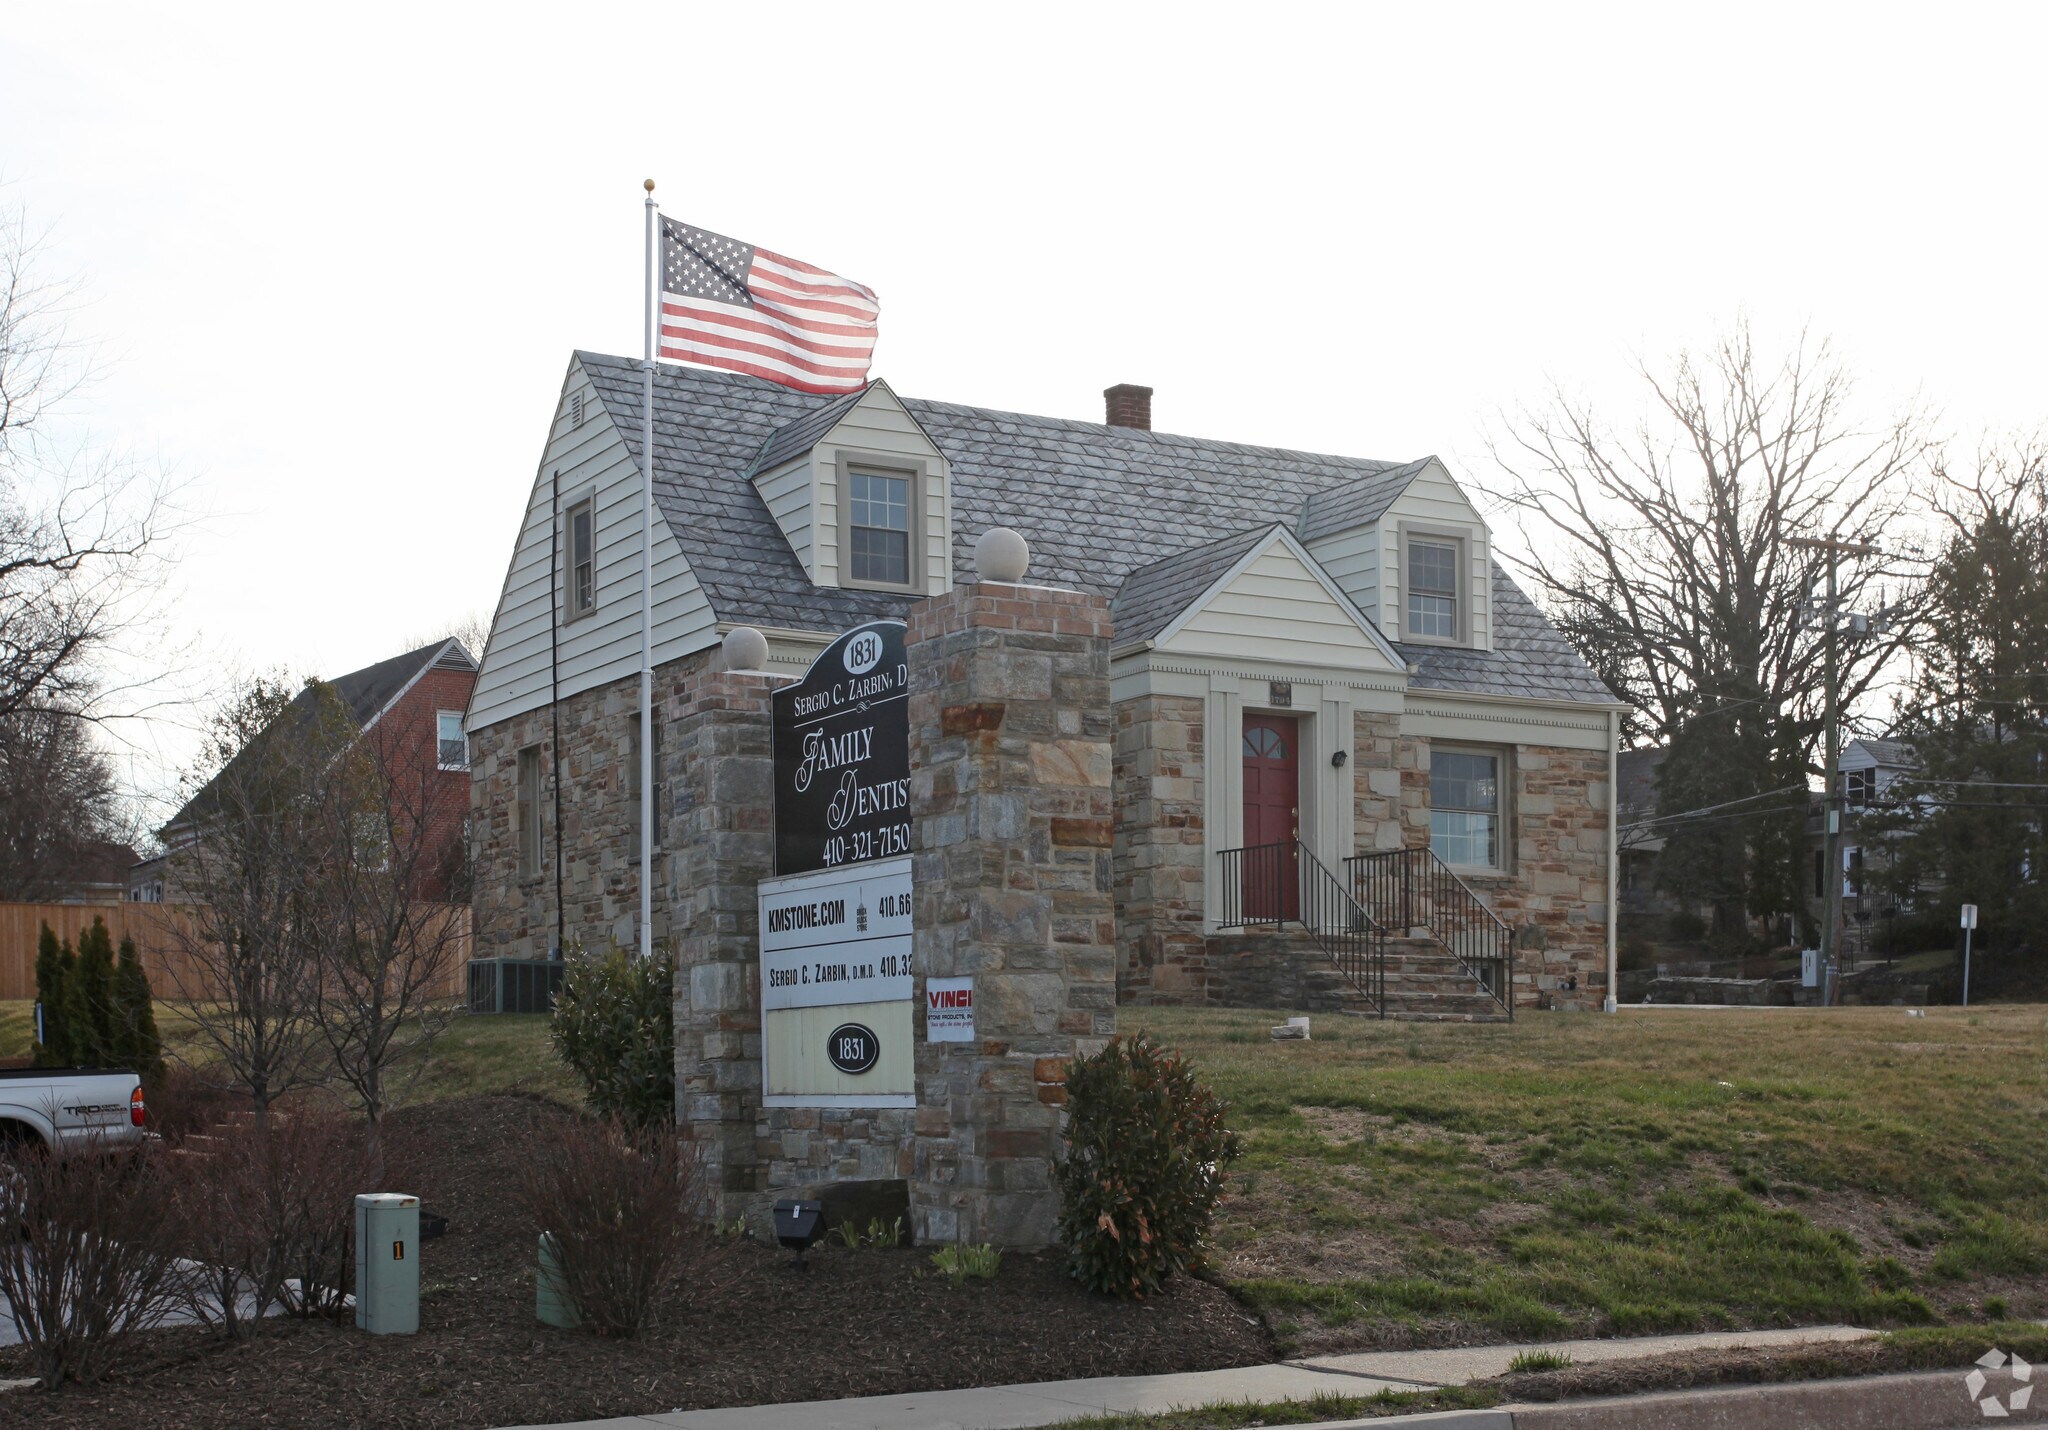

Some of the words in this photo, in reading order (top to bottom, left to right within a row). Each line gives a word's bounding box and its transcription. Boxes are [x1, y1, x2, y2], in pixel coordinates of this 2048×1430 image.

[850, 636, 877, 668] 1831
[794, 695, 830, 717] SERGIO
[833, 684, 845, 705] C.
[848, 672, 893, 700] ZARBIN,
[795, 726, 875, 793] FAMILY
[822, 823, 910, 868] 410-321-7150
[768, 899, 845, 933] KMSTONE.COM
[879, 893, 911, 918] 410.66
[770, 968, 798, 987] SERGIO
[802, 965, 811, 984] C.
[815, 963, 850, 983] ZARBIN,
[853, 964, 875, 980] D.M.D.
[929, 990, 972, 1008] VINCI
[839, 1037, 865, 1060] 1831
[63, 1105, 100, 1116] TRD
[394, 1242, 402, 1260] 1
